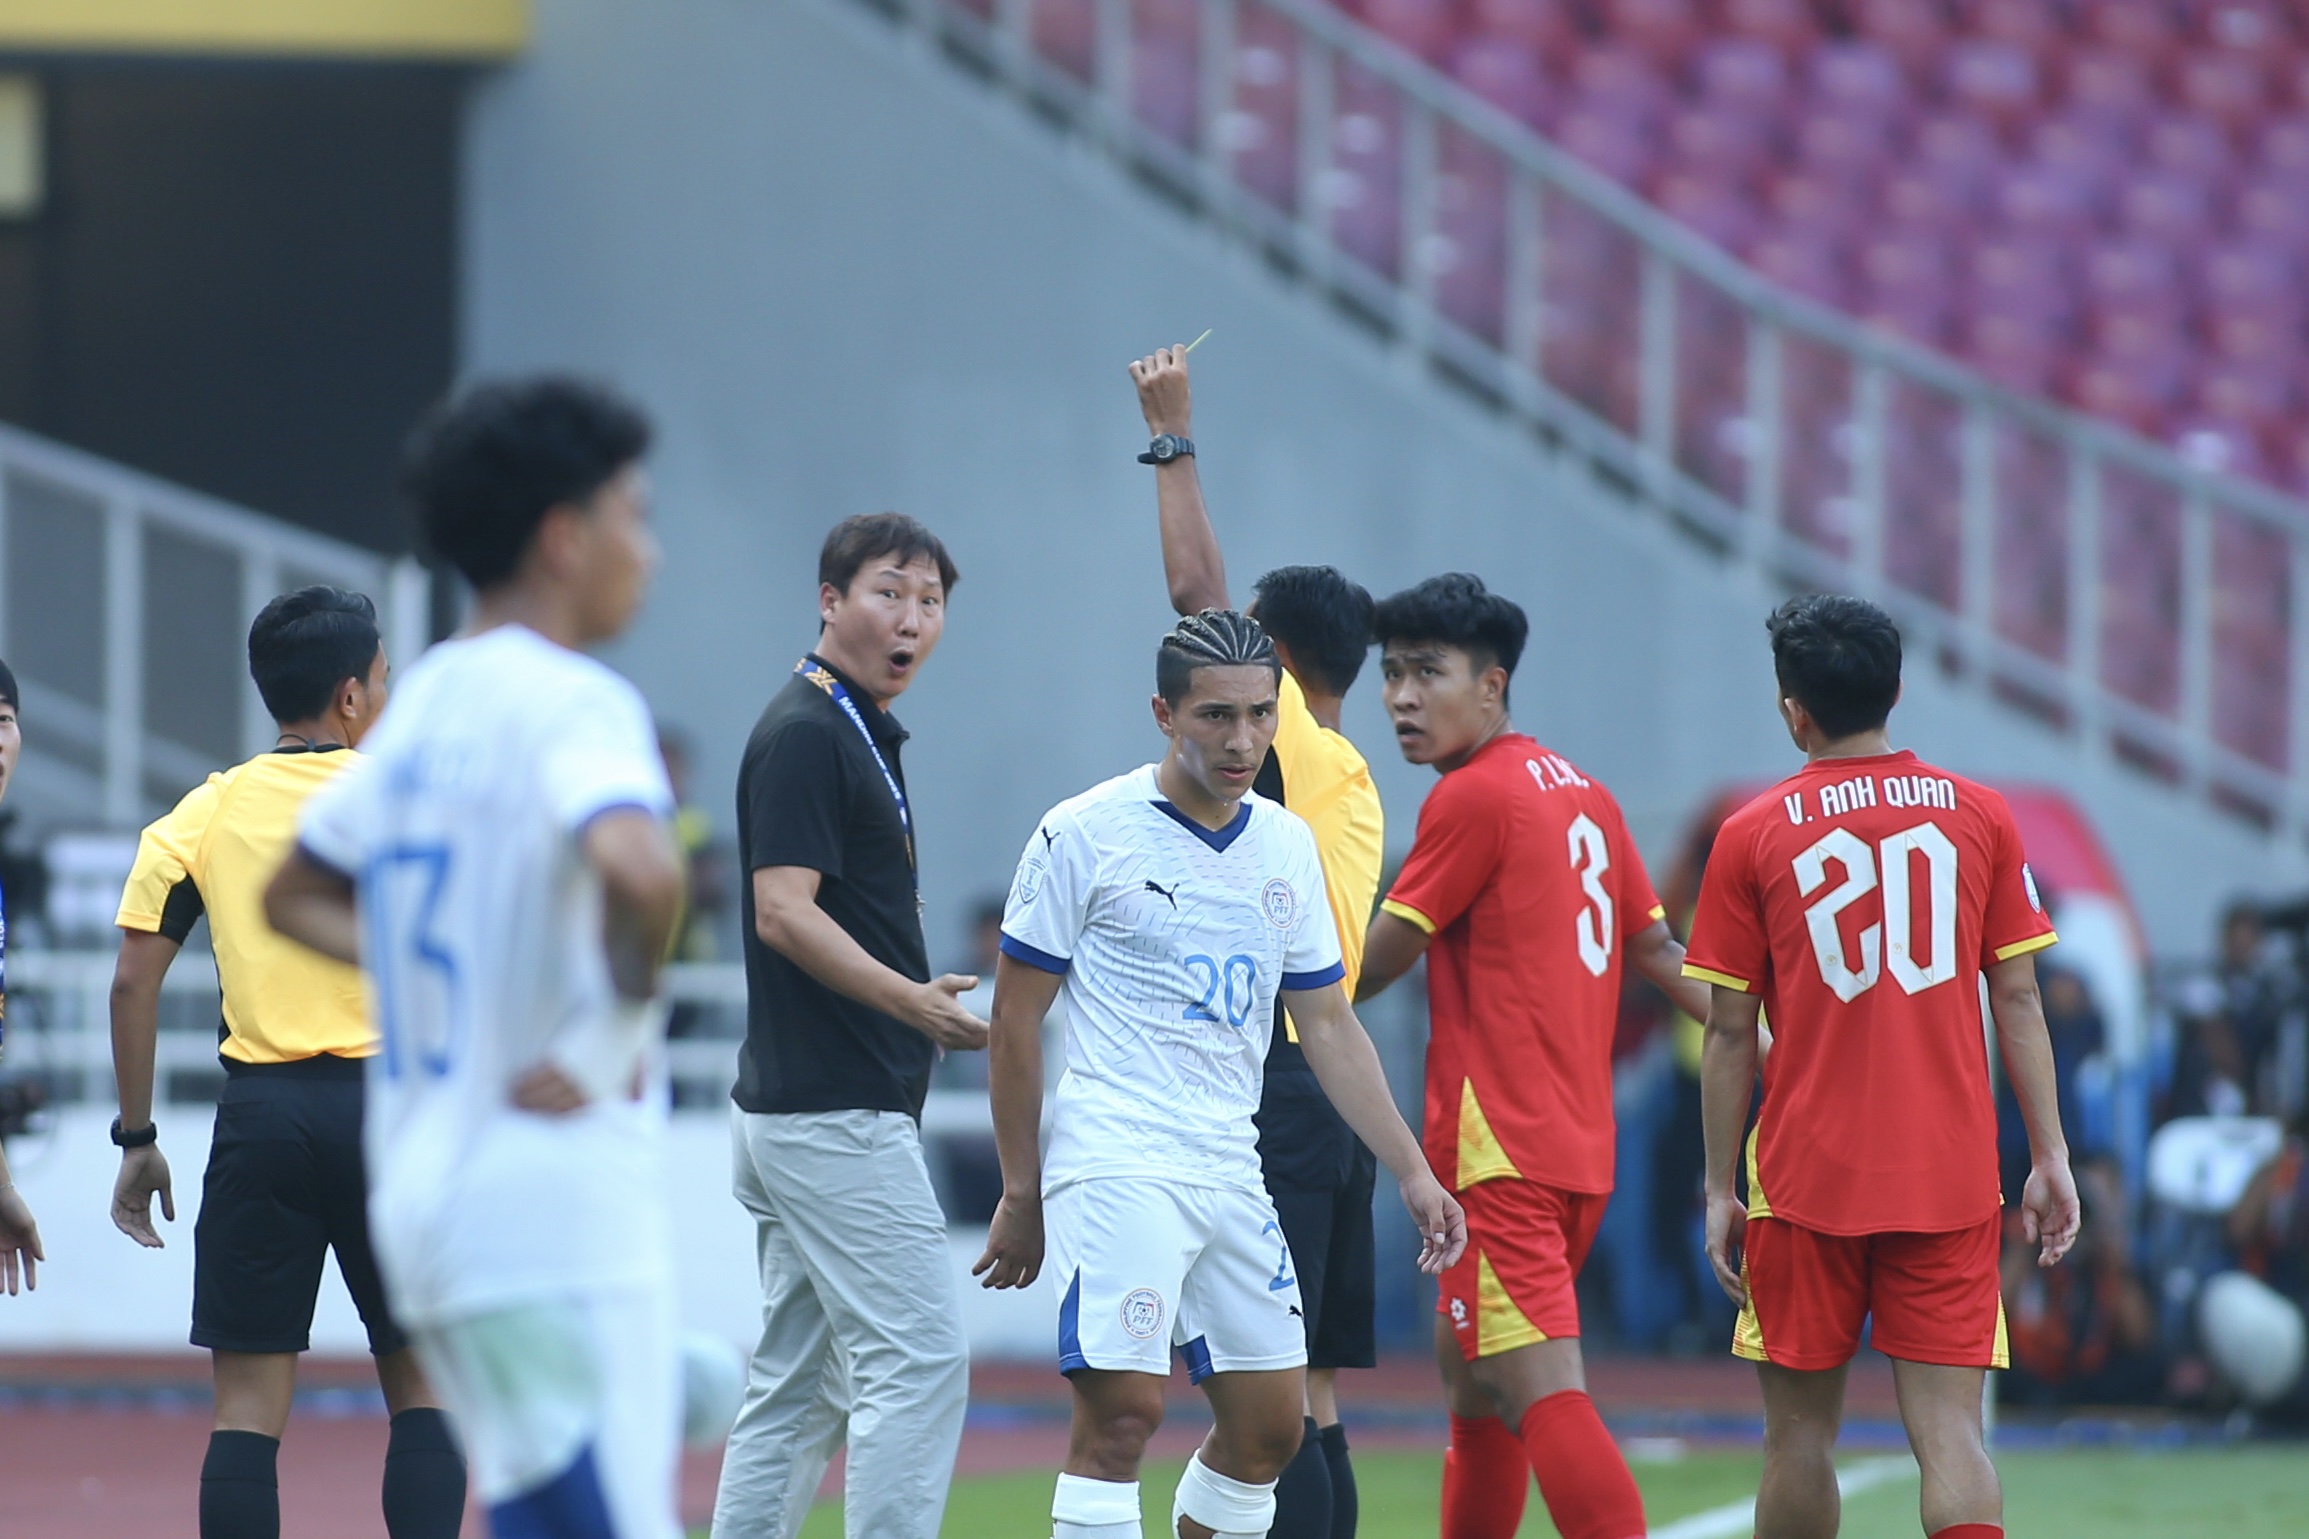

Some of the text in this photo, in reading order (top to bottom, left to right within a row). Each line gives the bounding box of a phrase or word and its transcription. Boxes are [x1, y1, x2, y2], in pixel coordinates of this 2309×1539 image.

[1784, 775, 1957, 826] V. ANH QUAN
[1566, 811, 1615, 978] 3
[1790, 820, 1959, 1004] 20
[358, 842, 462, 1081] 13
[1181, 954, 1257, 1027] 20
[1261, 1220, 1296, 1291] 2
